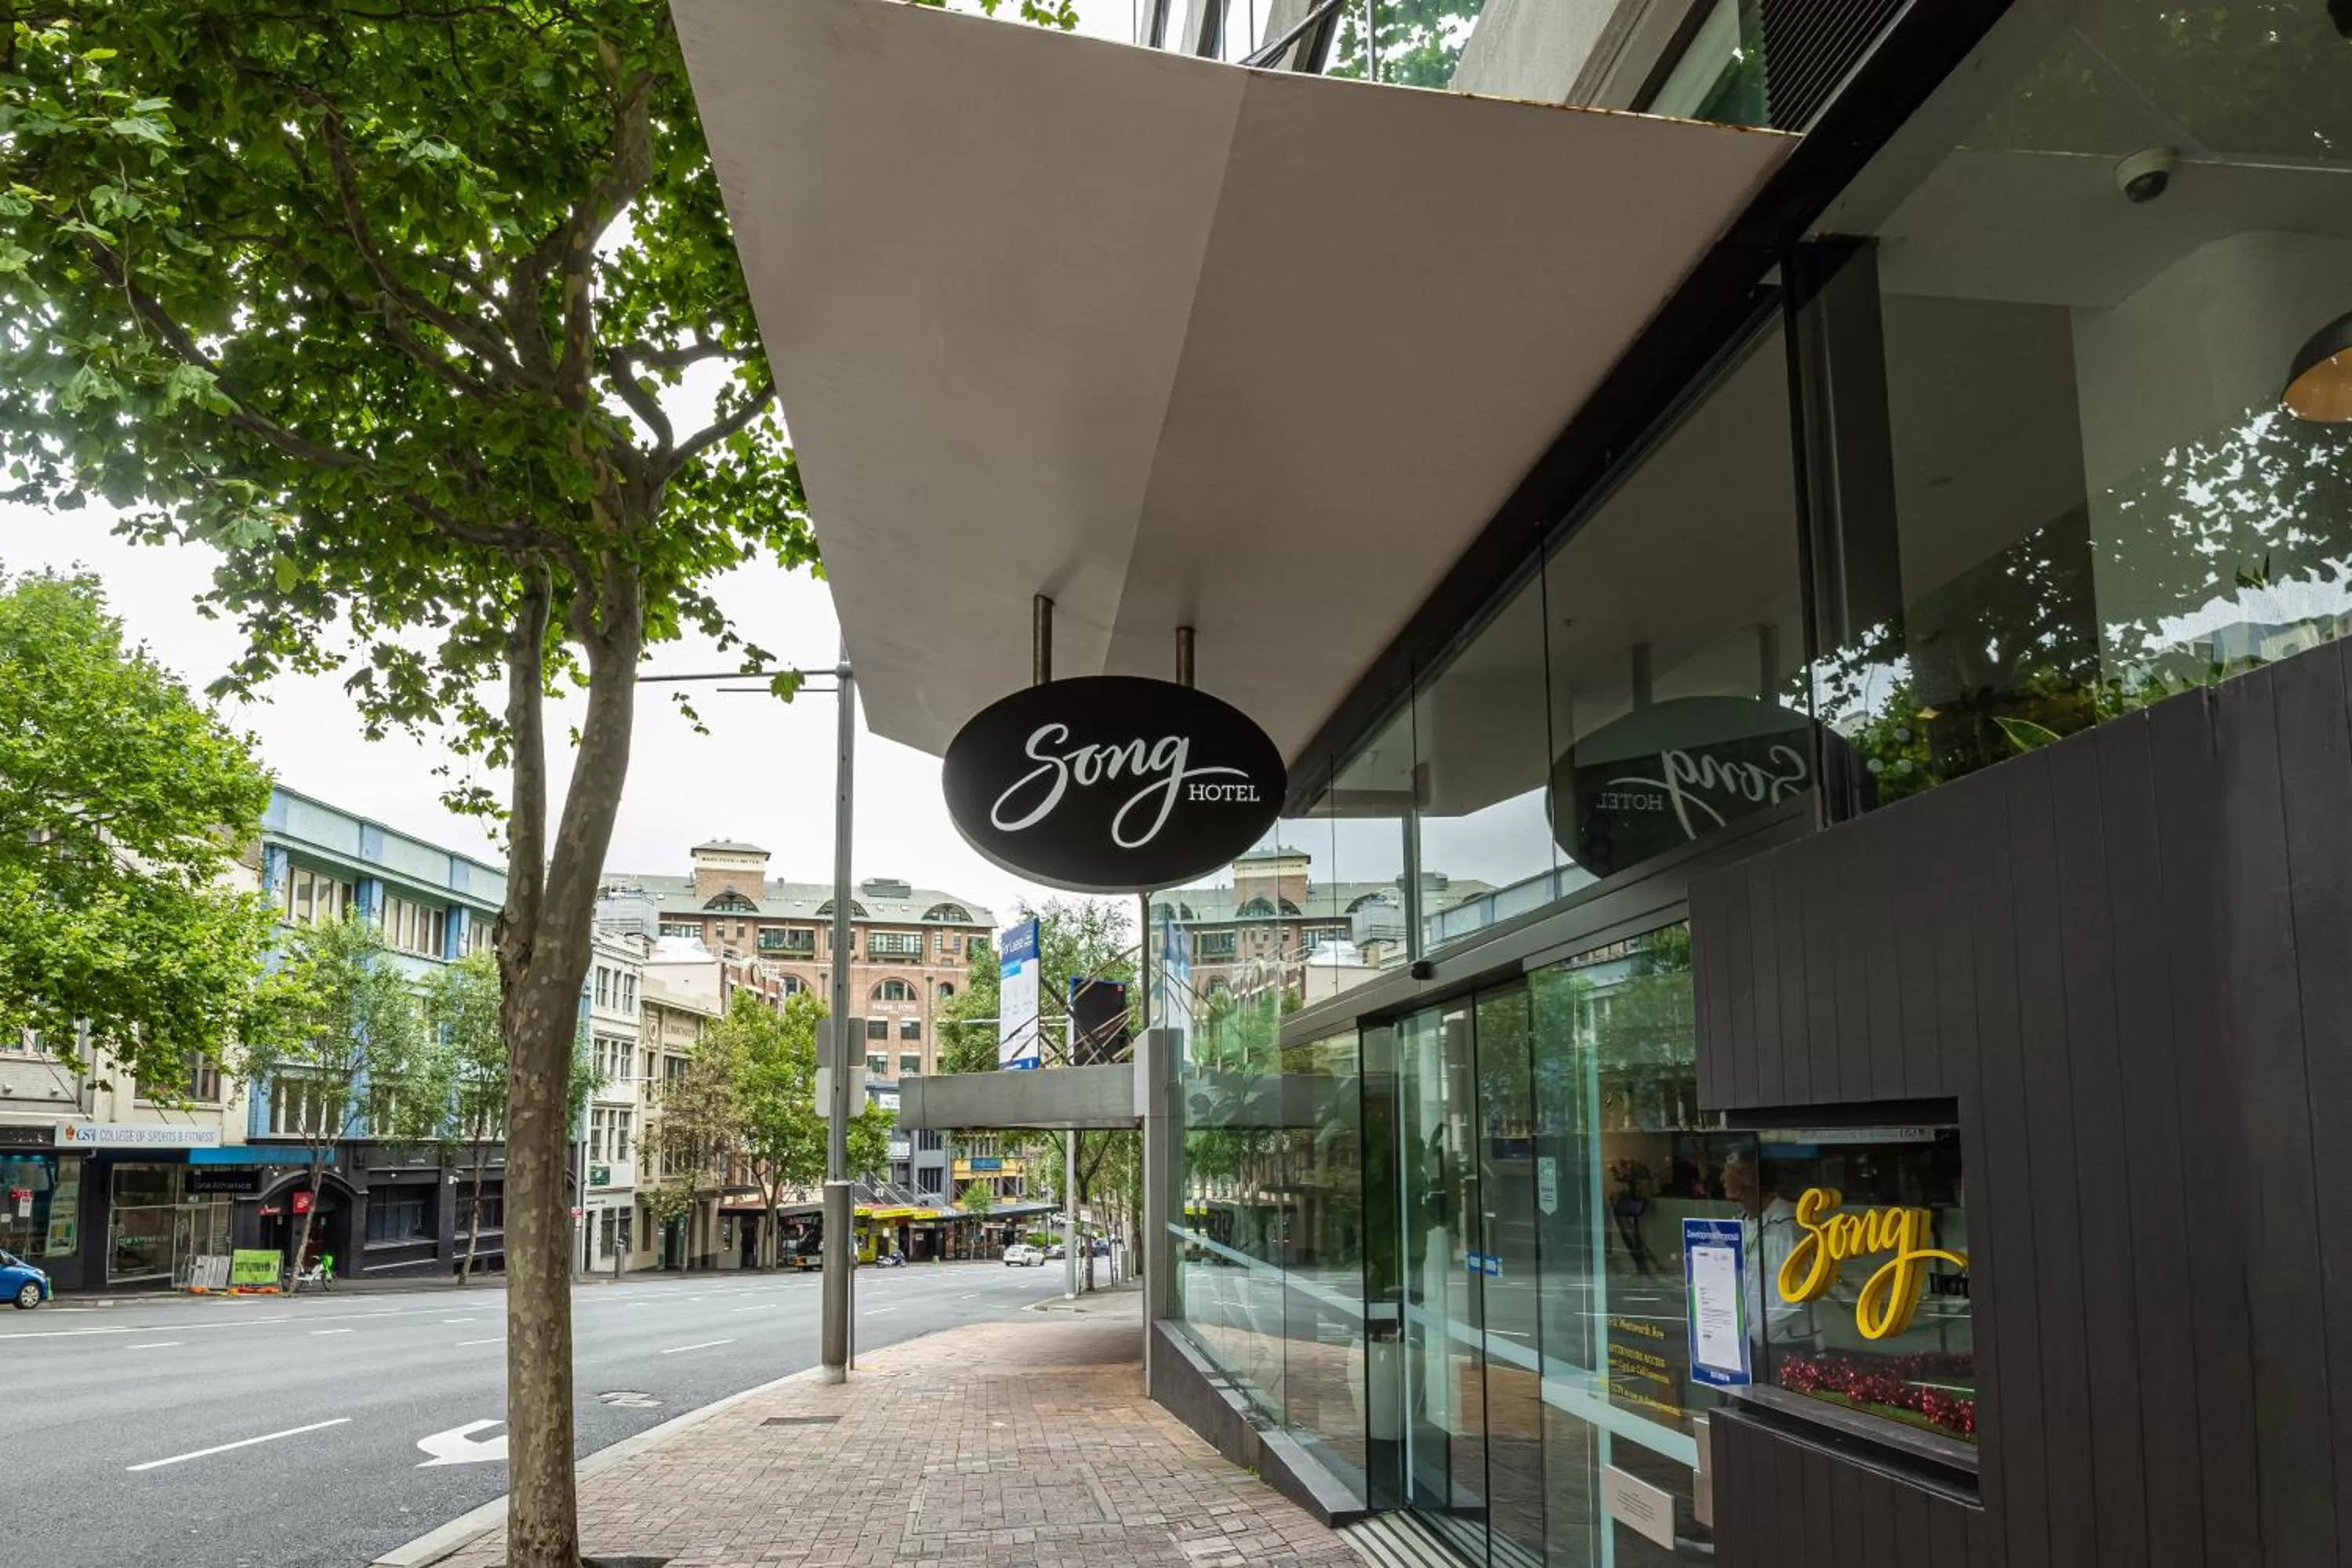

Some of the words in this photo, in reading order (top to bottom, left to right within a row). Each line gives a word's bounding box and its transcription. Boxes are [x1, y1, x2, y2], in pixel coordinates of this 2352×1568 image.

[990, 723, 1249, 848] Song
[1188, 784, 1260, 802] HOTEL
[100, 1129, 136, 1142] COLLEGE
[136, 1129, 146, 1142] OF
[147, 1129, 176, 1142] SPORTS
[183, 1130, 214, 1142] FITNESS
[1777, 1188, 1969, 1340] Song
